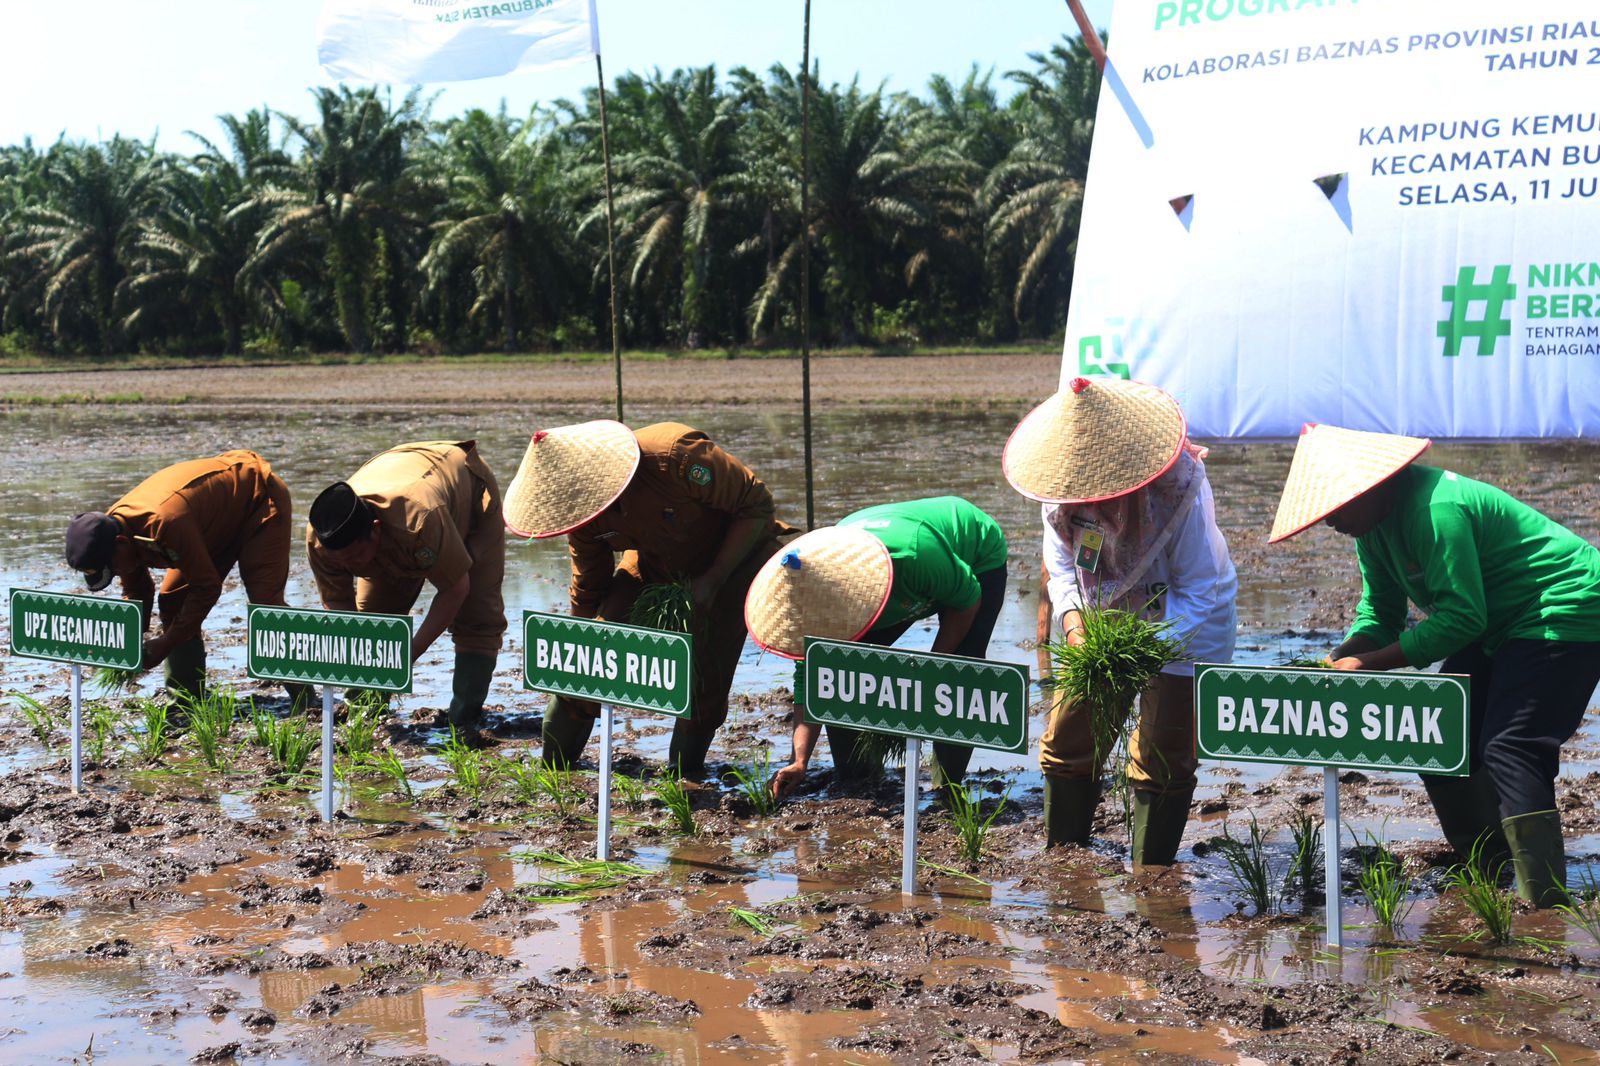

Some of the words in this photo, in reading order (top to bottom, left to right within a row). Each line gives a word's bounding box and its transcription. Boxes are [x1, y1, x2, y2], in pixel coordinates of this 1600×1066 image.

[1154, 0, 1359, 30] PROGR
[1142, 48, 1289, 83] KOLABORASI
[1296, 37, 1399, 62] BAZNAS
[1407, 25, 1533, 52] PROVINSI
[1541, 20, 1600, 41] RIAU
[1484, 48, 1578, 72] TAHUN
[1358, 118, 1501, 146] KAMPUNG
[1511, 112, 1600, 136] KEMU
[1371, 147, 1551, 176] KECAMATAN
[1562, 145, 1600, 166] BU
[1398, 181, 1518, 206] SELASA,
[1529, 179, 1550, 200] 11
[1561, 177, 1598, 198] JU
[1526, 293, 1600, 319] BER
[1525, 325, 1599, 339] TENTRAM
[24, 611, 48, 640] UPZ
[51, 614, 125, 649] KECAMATAN
[255, 629, 286, 660] KADIS
[289, 632, 347, 665] PERTANIAN
[350, 637, 403, 670] KAB.SIAK
[536, 638, 618, 680] BAZNAS
[625, 652, 676, 691] RIAU
[817, 666, 922, 713] BUPATI
[934, 683, 1009, 726] SIAK
[1217, 695, 1349, 739] BAZNAS
[1360, 703, 1443, 745] SIAK
